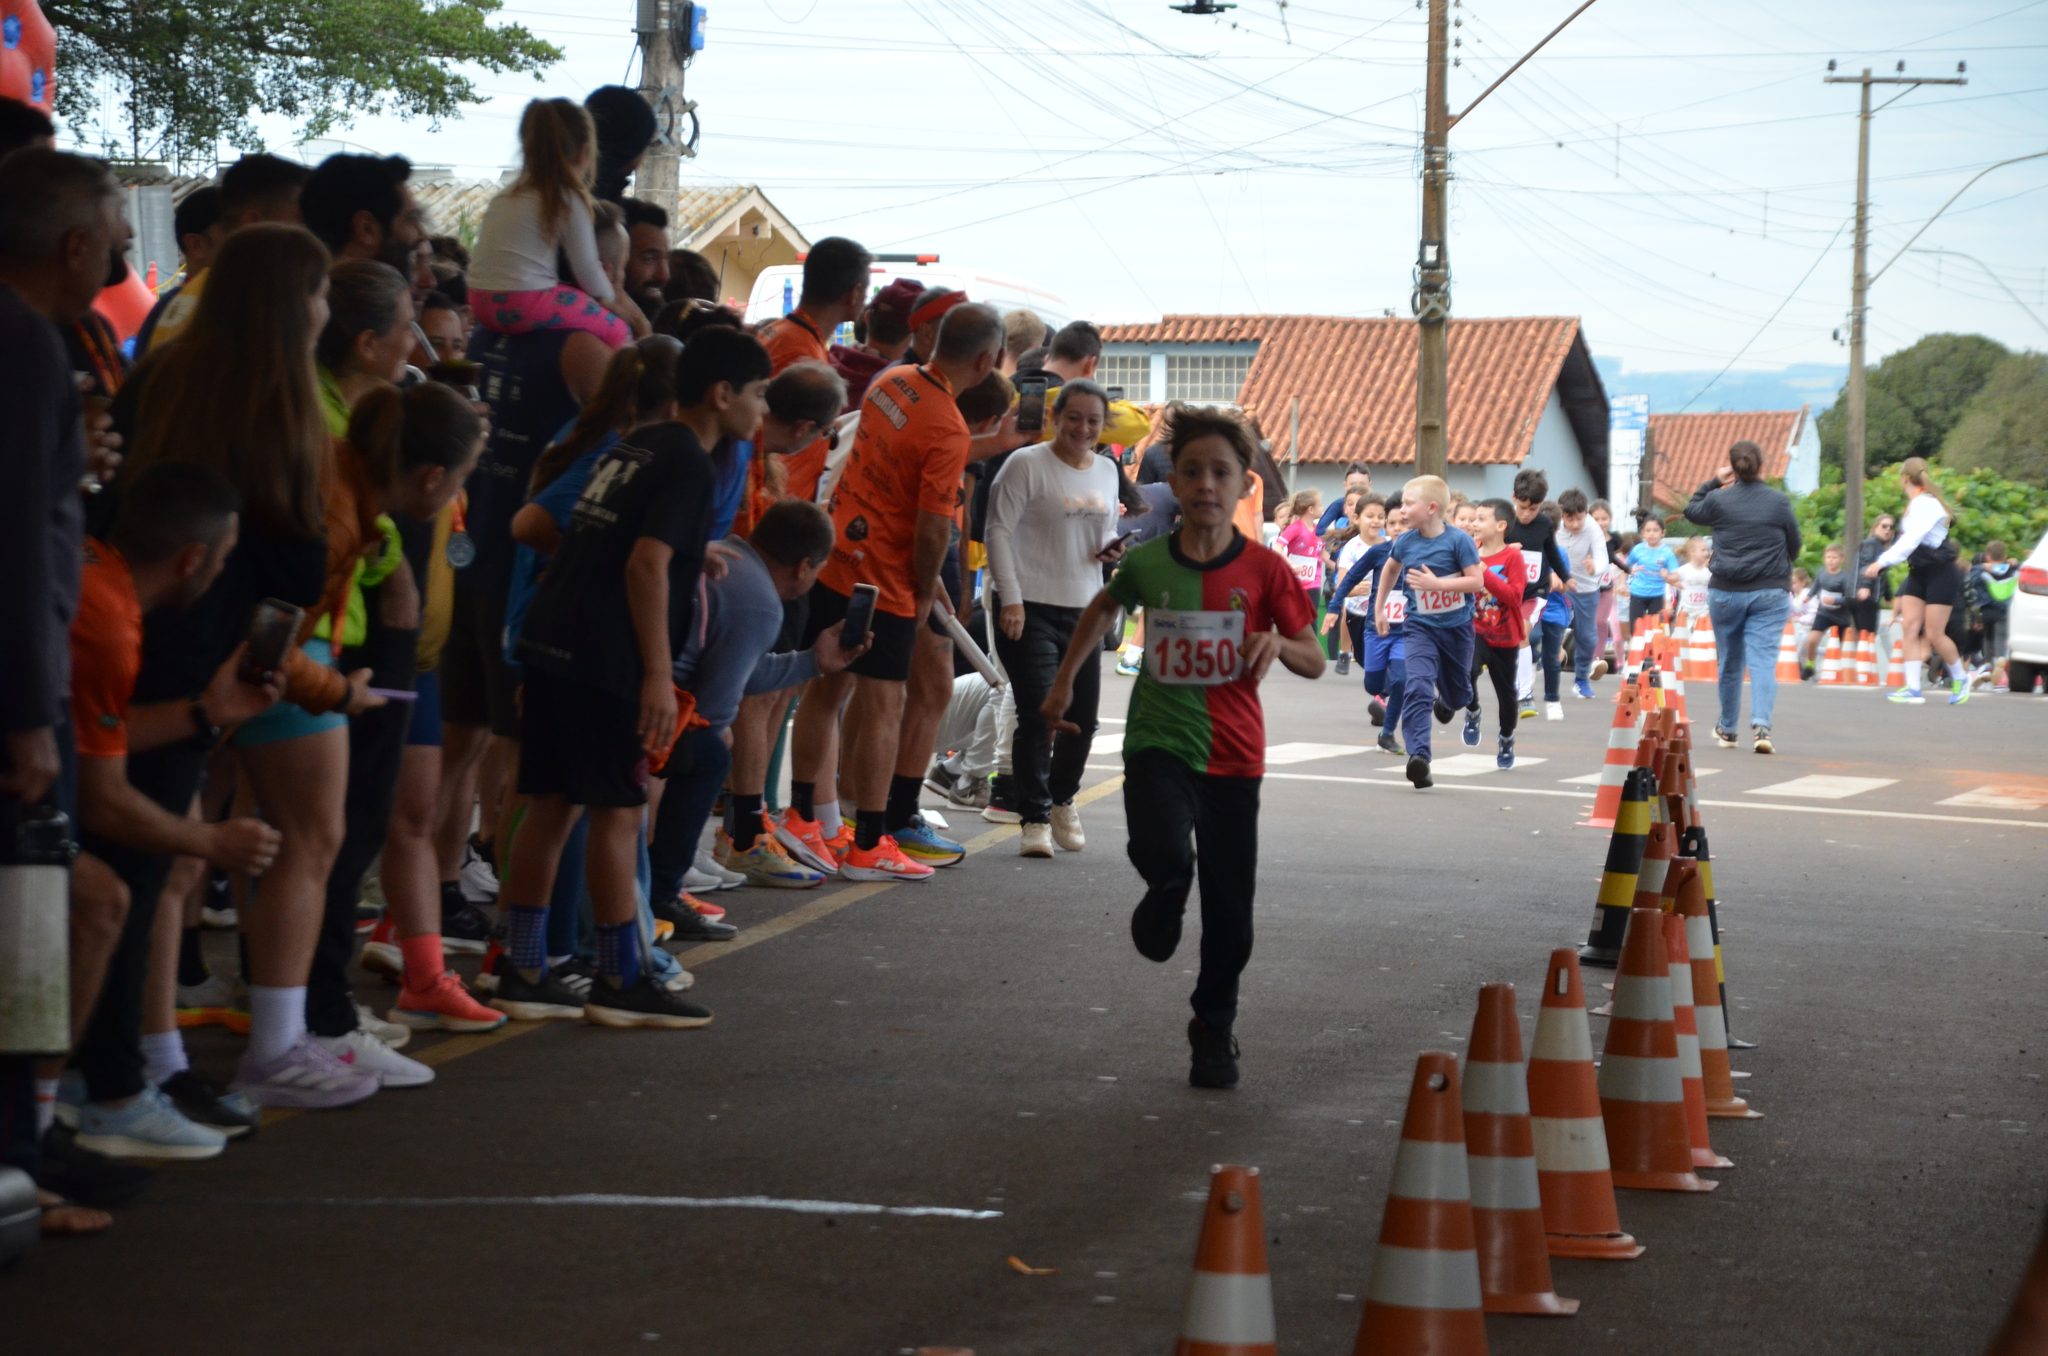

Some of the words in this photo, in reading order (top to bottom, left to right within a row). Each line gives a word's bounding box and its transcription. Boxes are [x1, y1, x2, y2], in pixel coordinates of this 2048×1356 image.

[891, 376, 920, 405] ATLETA
[1420, 589, 1462, 610] 1264
[1155, 637, 1236, 678] 1350
[875, 859, 905, 871] FILA
